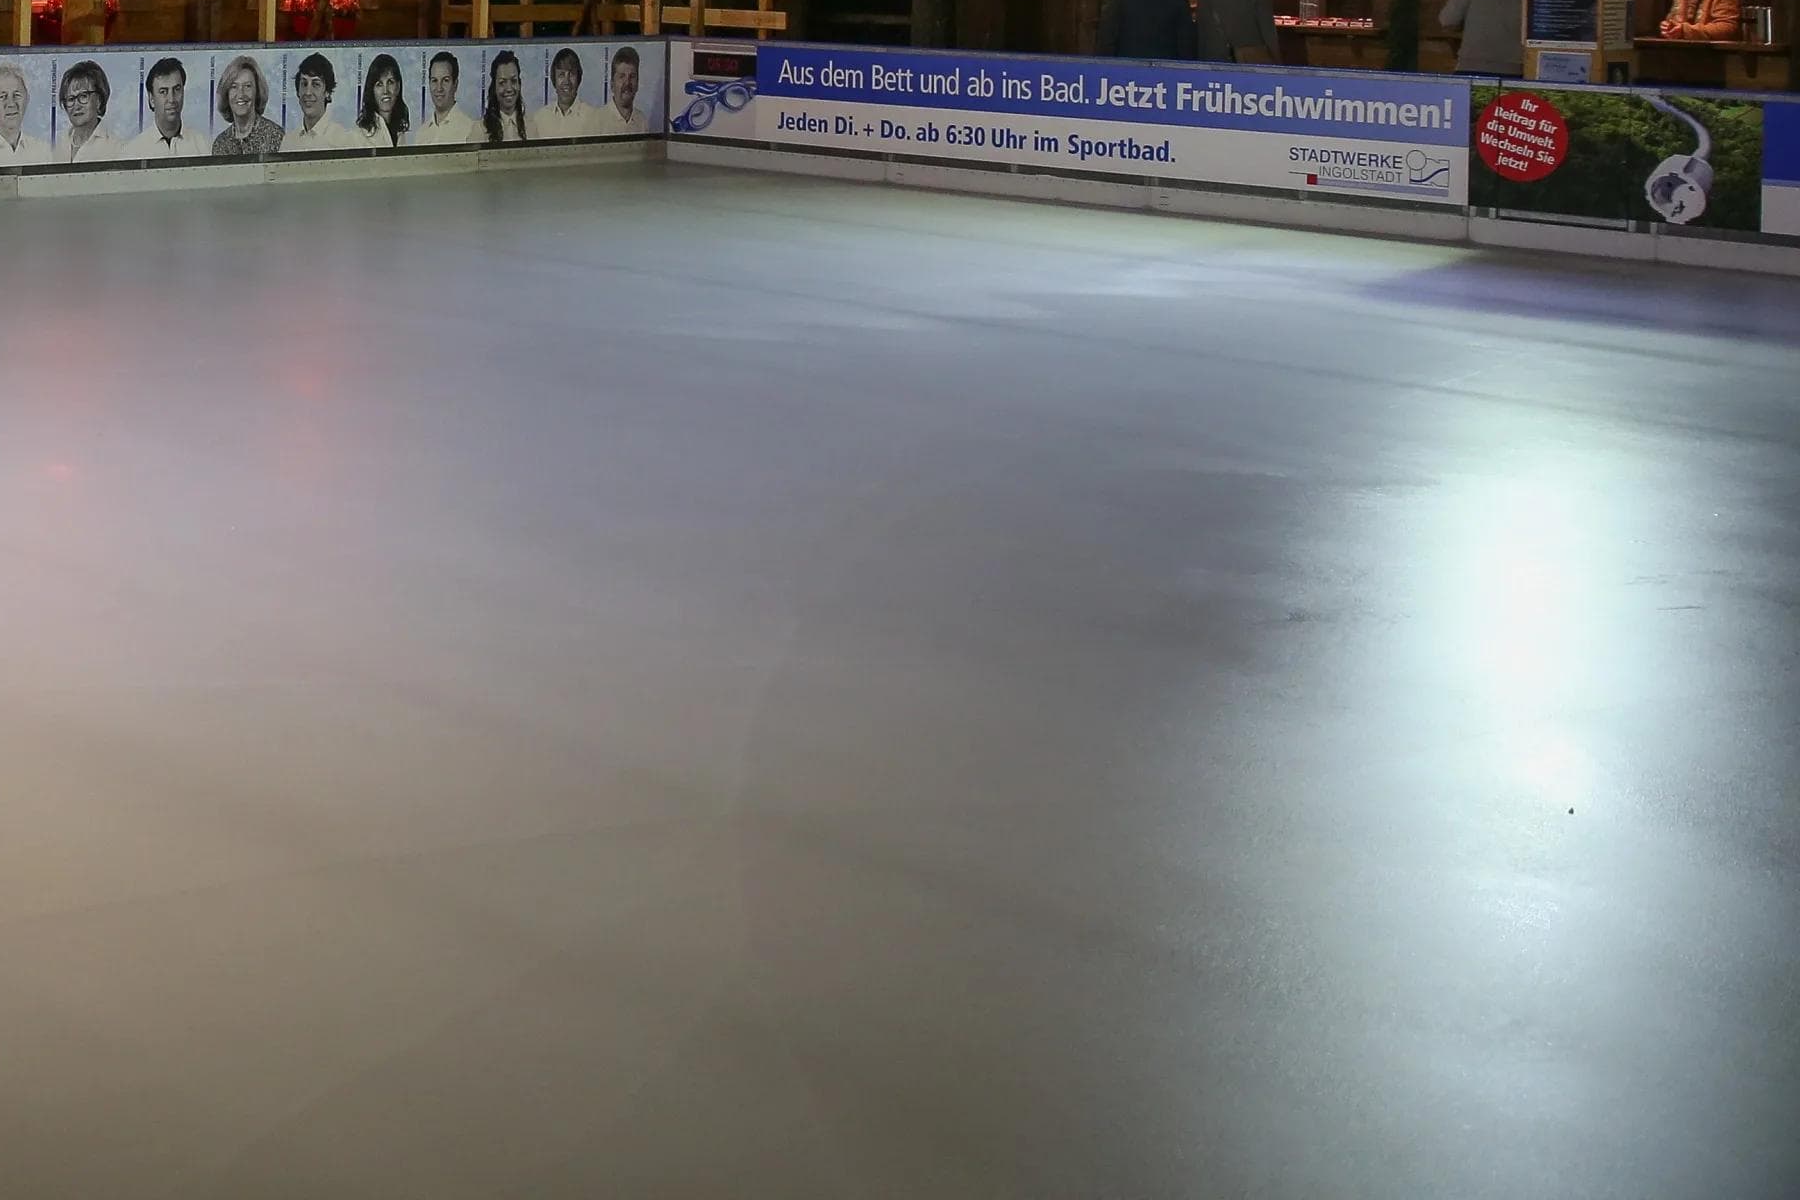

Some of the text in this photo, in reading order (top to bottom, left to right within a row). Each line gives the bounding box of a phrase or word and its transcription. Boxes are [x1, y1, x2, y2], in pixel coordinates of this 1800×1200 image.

[778, 59, 1452, 129] Aus dem Bett und ab ins Bad. Jetzt Frühschwimmen!
[1521, 99, 1538, 112] Ihr
[1494, 106, 1558, 134] Beitrag für
[777, 111, 1176, 162] Jeden Di. + Do. ab 6:30 Uhr im Sportbad.
[1481, 132, 1555, 165] Wechseln Sie
[1487, 119, 1556, 150] die Umwelt.
[1289, 147, 1403, 169] STADTWERKE
[1496, 152, 1529, 171] jetzt!
[1319, 166, 1403, 183] INGOLSTADT
